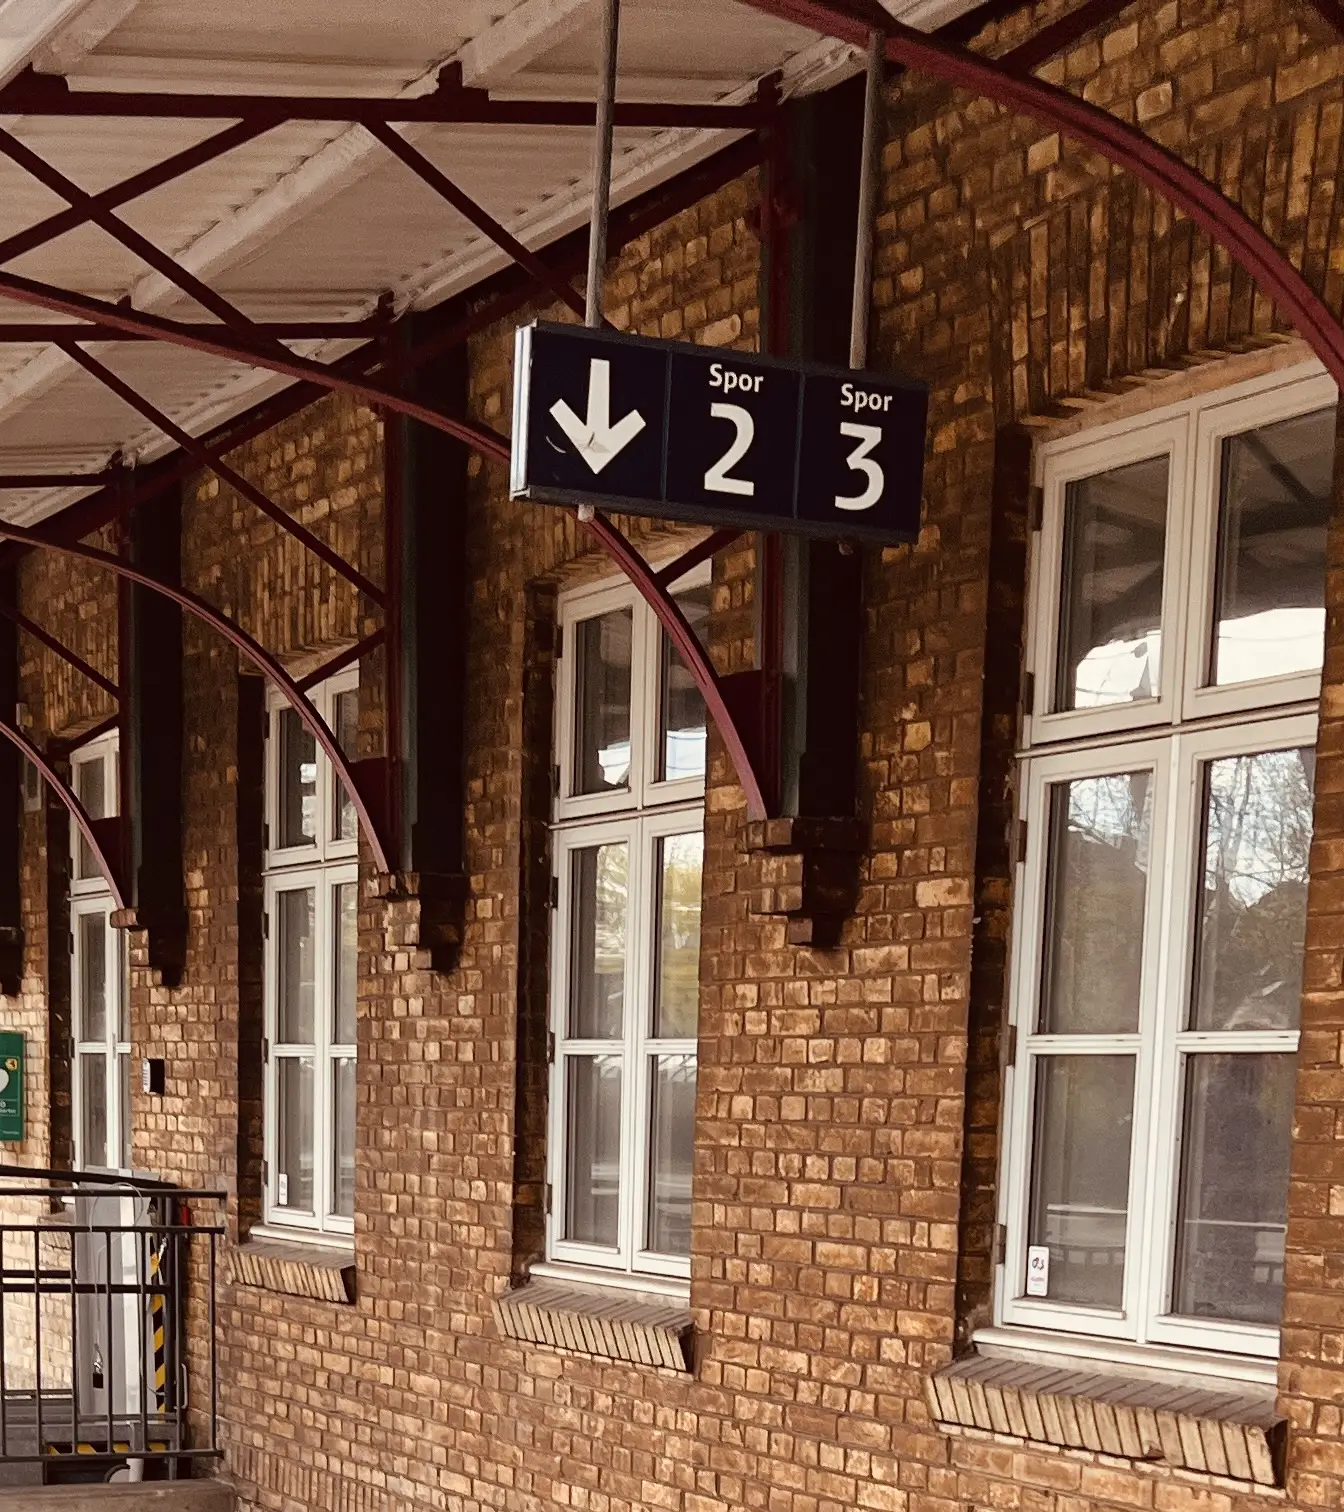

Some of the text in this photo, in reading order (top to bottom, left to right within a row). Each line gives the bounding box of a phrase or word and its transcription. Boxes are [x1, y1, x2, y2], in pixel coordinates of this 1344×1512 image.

[709, 364, 763, 393] Spor
[841, 383, 892, 412] Spor
[705, 403, 754, 495] 2
[835, 422, 884, 510] 3
